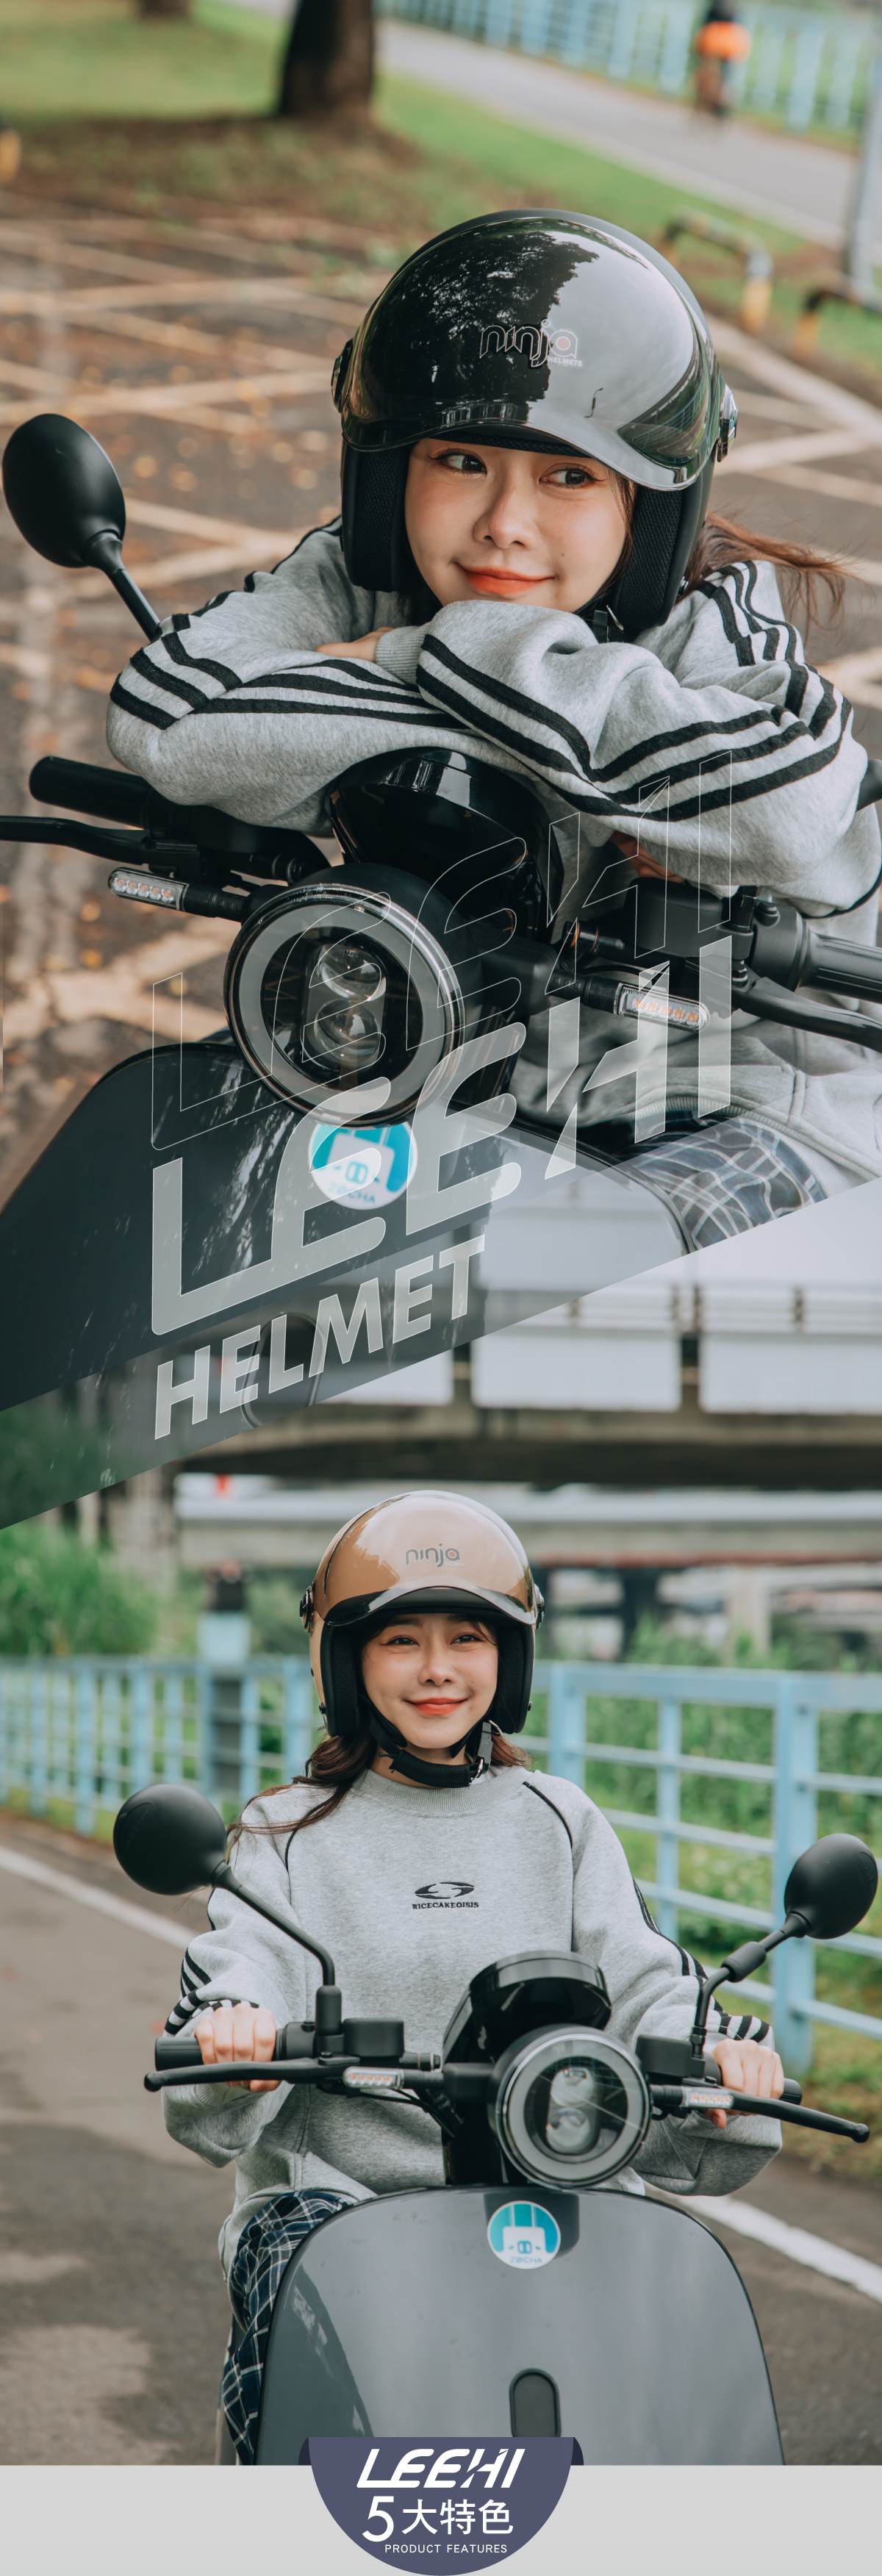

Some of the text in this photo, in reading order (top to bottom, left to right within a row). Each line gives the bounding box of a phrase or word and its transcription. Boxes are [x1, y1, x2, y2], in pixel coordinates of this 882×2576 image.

[479, 318, 578, 367] ninja
[548, 356, 583, 367] HELMETS
[405, 1542, 461, 1568] ninja
[412, 1901, 479, 1909] RICECAKEOISIS
